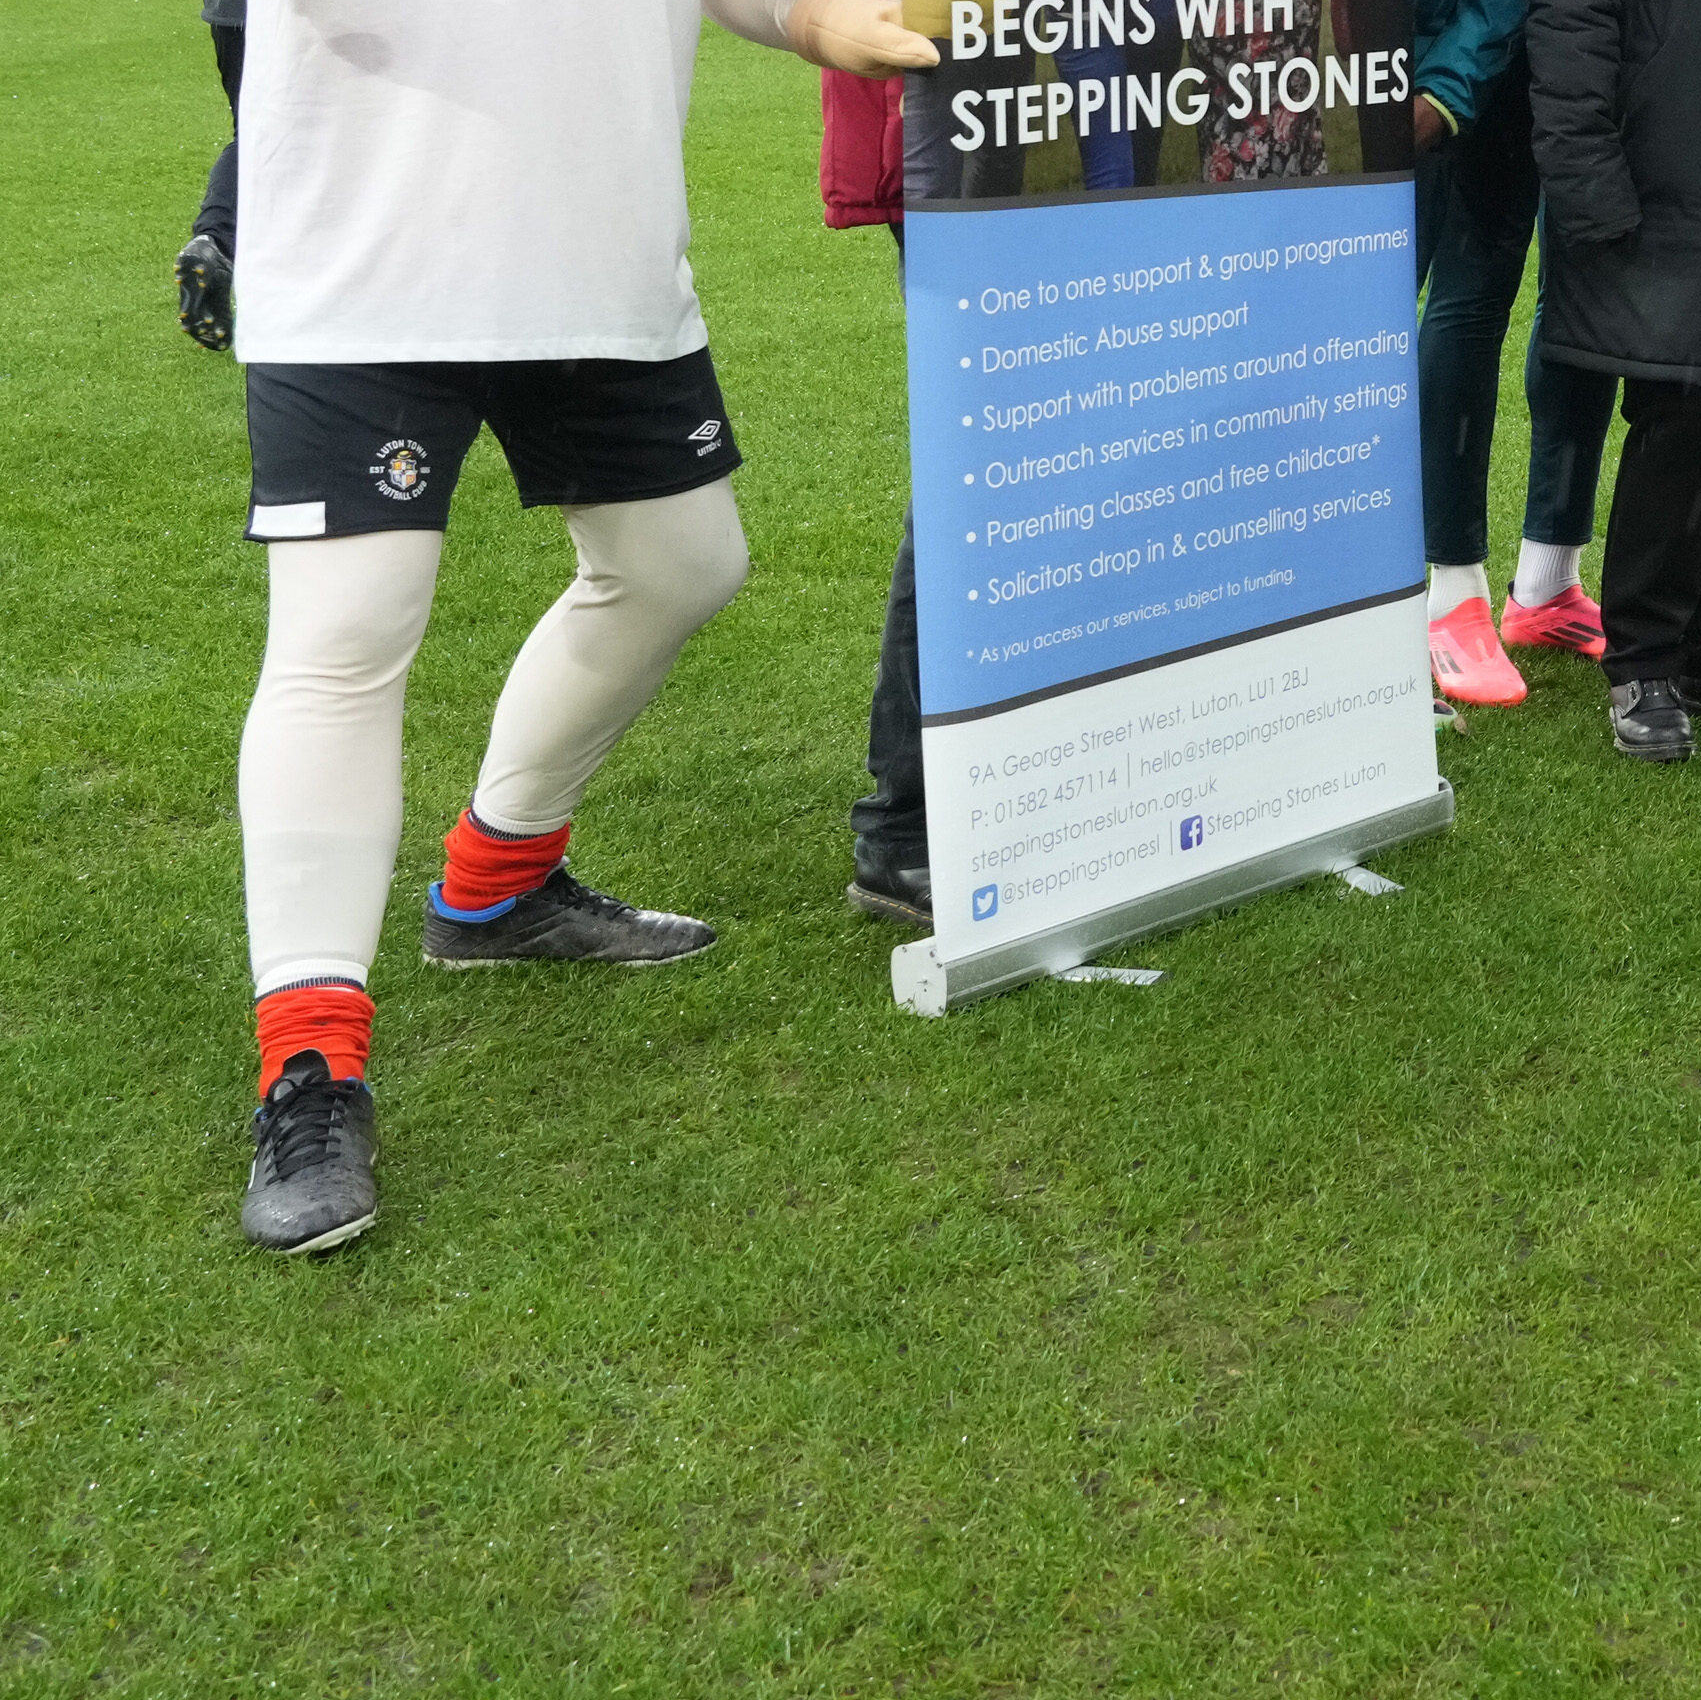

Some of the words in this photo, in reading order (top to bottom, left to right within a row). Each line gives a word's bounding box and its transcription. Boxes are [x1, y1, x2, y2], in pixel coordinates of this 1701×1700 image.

[950, 67, 1210, 152] STEPPING
[1226, 47, 1410, 120] STONES
[980, 287, 1031, 315] One
[1037, 280, 1059, 305] to
[1065, 277, 1107, 302] one
[1112, 256, 1192, 294] support
[1199, 254, 1214, 279] &
[1219, 247, 1279, 281] group
[1285, 226, 1409, 271] programmes
[982, 332, 1088, 374] Domestic
[1095, 311, 1164, 351] Abuse
[1169, 301, 1249, 340] support
[982, 391, 1072, 433] Support
[1077, 383, 1122, 411] with
[1129, 363, 1228, 407] problems
[1233, 343, 1307, 381] around
[1313, 328, 1409, 366] offending
[369, 466, 385, 474] EST
[376, 439, 405, 459] LUTON
[407, 439, 428, 459] TOWN
[985, 443, 1094, 489] Outreach
[1100, 427, 1185, 463] services
[1190, 421, 1208, 443] in
[1214, 395, 1328, 440] community
[1333, 380, 1407, 416] settings
[375, 480, 412, 500] FOOTBALL
[412, 480, 427, 498] CLUB
[987, 501, 1095, 547] Parenting
[1101, 484, 1175, 520] classes
[1181, 473, 1224, 500] and
[1229, 462, 1269, 488] free
[988, 563, 1082, 605] Solicitors
[1089, 549, 1141, 579] drop
[1146, 538, 1165, 563] in
[1172, 533, 1187, 557] &
[1193, 505, 1307, 552] counselling
[1312, 487, 1392, 522] services
[980, 645, 998, 665] As
[1003, 638, 1029, 661] you
[1033, 623, 1083, 650] access
[1087, 617, 1109, 637] our
[1113, 600, 1171, 627] services,
[1174, 586, 1223, 614] subject
[1226, 581, 1241, 597] to
[1243, 565, 1296, 594] funding.
[969, 764, 997, 788] 9A
[1002, 743, 1075, 777] George
[1080, 723, 1133, 753] Street
[1137, 708, 1187, 737] West,
[1191, 692, 1243, 721] Luton,
[1248, 678, 1276, 702] LU1
[1282, 667, 1309, 693] 2BJ
[970, 809, 989, 831] P:
[994, 788, 1048, 824] 01582
[1054, 768, 1117, 804] 457114
[1140, 674, 1417, 778] hello@steppingstonesluton.org.uk
[971, 774, 1218, 874] steppingstonesluton.org.uk
[1001, 834, 1160, 905] @steppingstonesl
[1207, 798, 1282, 838] Stepping
[1286, 777, 1339, 809] Stones
[1344, 761, 1386, 788] Luton
